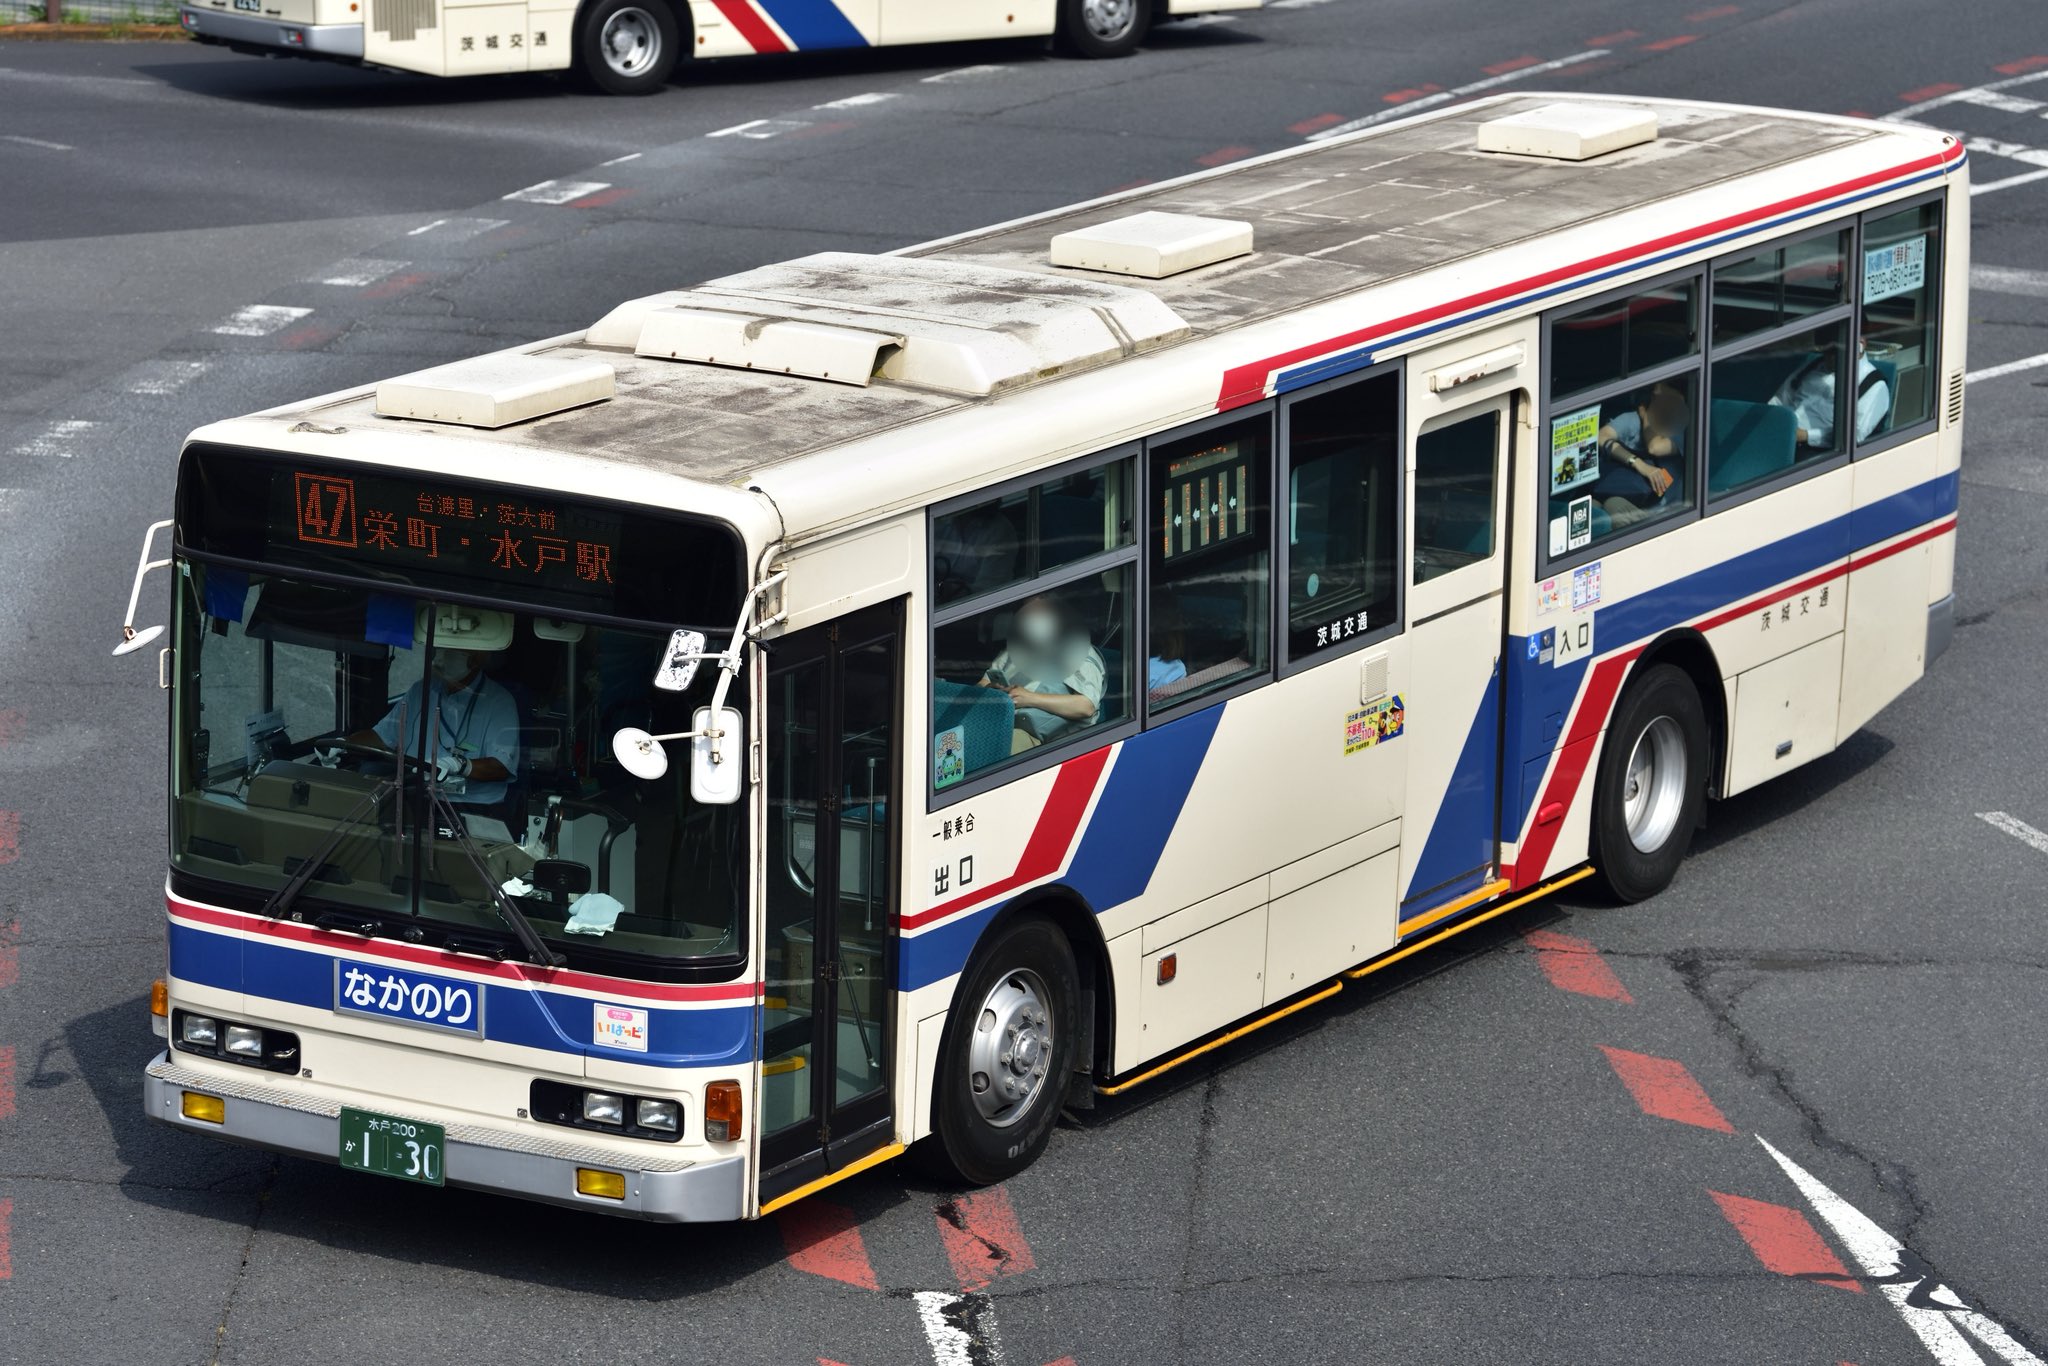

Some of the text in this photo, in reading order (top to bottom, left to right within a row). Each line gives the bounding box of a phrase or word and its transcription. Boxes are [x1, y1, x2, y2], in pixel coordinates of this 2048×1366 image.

[304, 483, 347, 536] 47
[363, 511, 613, 584] 栄町・水戸駅
[1317, 611, 1367, 647] 茨城交通
[1560, 622, 1589, 655] 入口
[933, 813, 975, 841] 一般乗合
[934, 855, 973, 896] 出口
[344, 967, 472, 1024] なかのり
[598, 1021, 643, 1039] いばっピ
[345, 1140, 356, 1152] か
